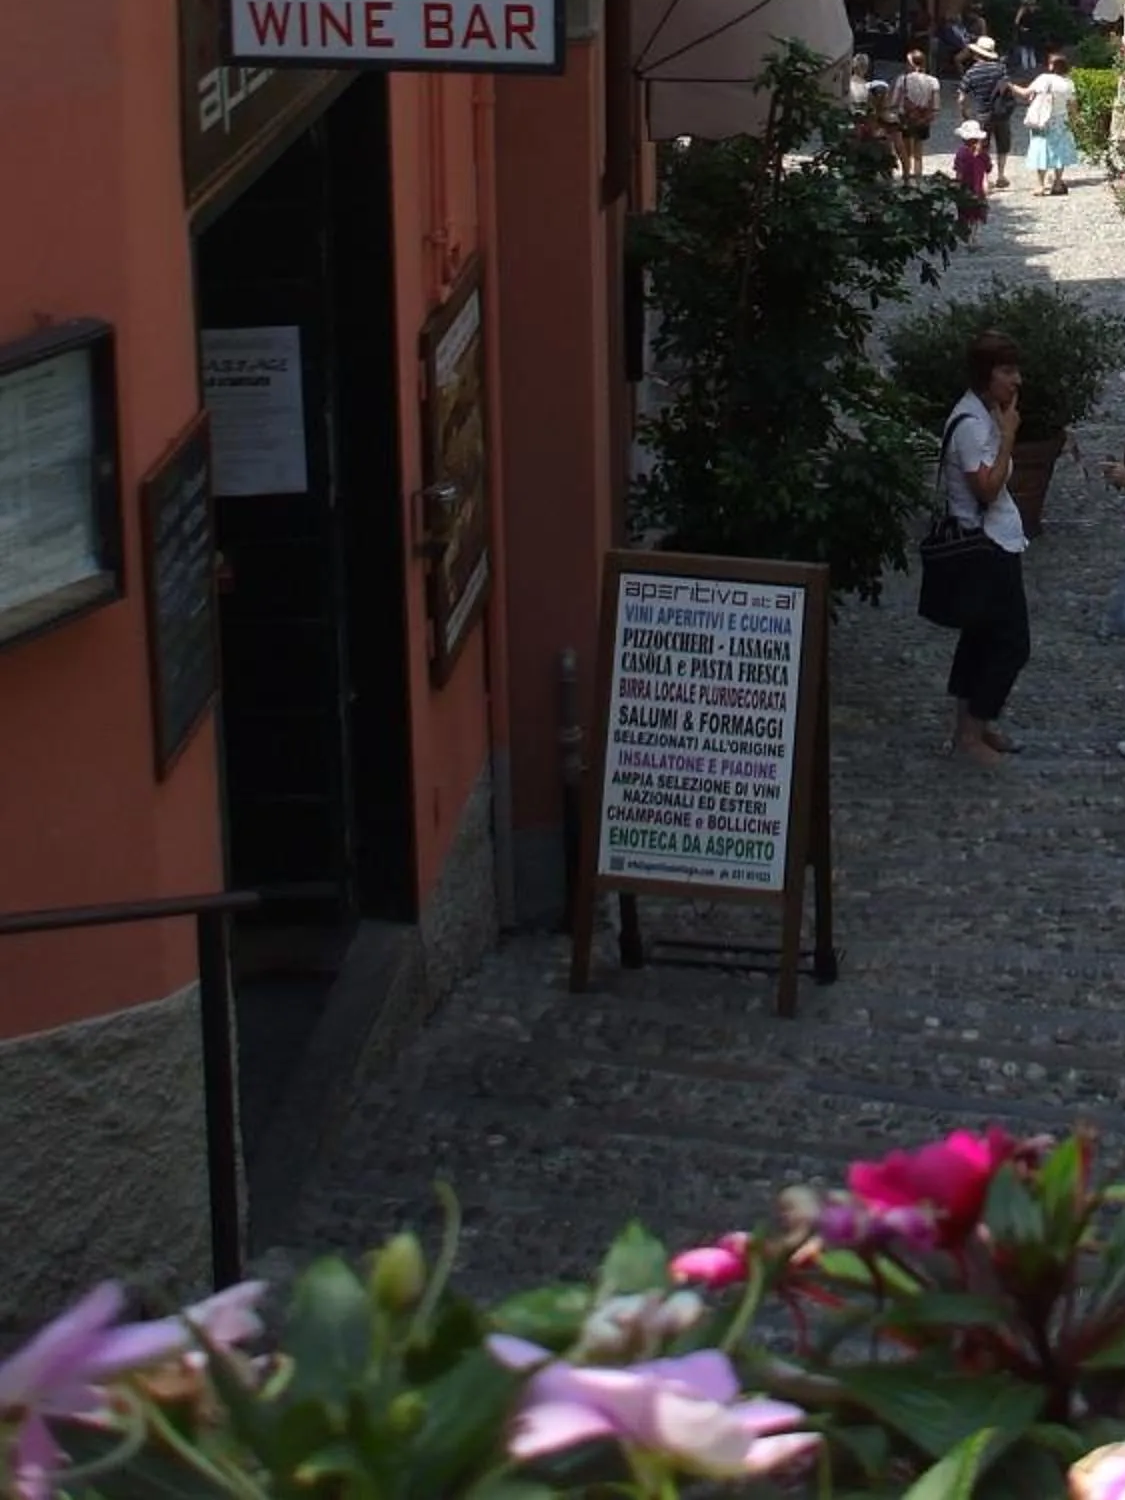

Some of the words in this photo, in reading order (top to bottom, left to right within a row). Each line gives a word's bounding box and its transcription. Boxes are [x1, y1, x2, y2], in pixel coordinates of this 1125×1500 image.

[248, 1, 395, 48] WINE
[422, 2, 538, 51] BAR
[625, 581, 748, 607] aperitivo
[625, 602, 653, 624] VINI
[657, 607, 725, 631] APERITIVI
[728, 612, 736, 631] E
[741, 612, 792, 636] CUCINA
[623, 627, 714, 655] PIZZOCCHERI
[729, 635, 791, 663] LASAGNA
[678, 659, 687, 677] e
[691, 656, 733, 682] PASTA
[738, 661, 789, 687] FRESCA
[619, 677, 651, 700] BIRRA
[654, 680, 696, 705] LOCALE
[699, 683, 787, 713] PLURIDECORATA
[619, 704, 678, 731] SALUMI
[684, 709, 694, 732] &
[700, 711, 784, 741] FORMAGGI
[614, 729, 700, 752] SELEZIONATI
[702, 736, 786, 759] ALL'ORIGINE
[618, 748, 706, 773] INSALATONE
[708, 757, 718, 775] E
[721, 758, 778, 781] PIADINE
[612, 770, 654, 789] AMPIA
[657, 773, 732, 796] SELEZIONE
[735, 781, 749, 798] DI
[753, 783, 782, 801] VINI
[623, 788, 695, 810] NAZIONALI
[698, 794, 716, 812] ED
[720, 797, 768, 817] ESTERI
[608, 804, 692, 829] CHAMPAGNE
[707, 814, 782, 837] BOLLICINE
[609, 825, 677, 854] ENOTECA
[682, 832, 702, 855] DA
[705, 834, 776, 862] ASPORTO
